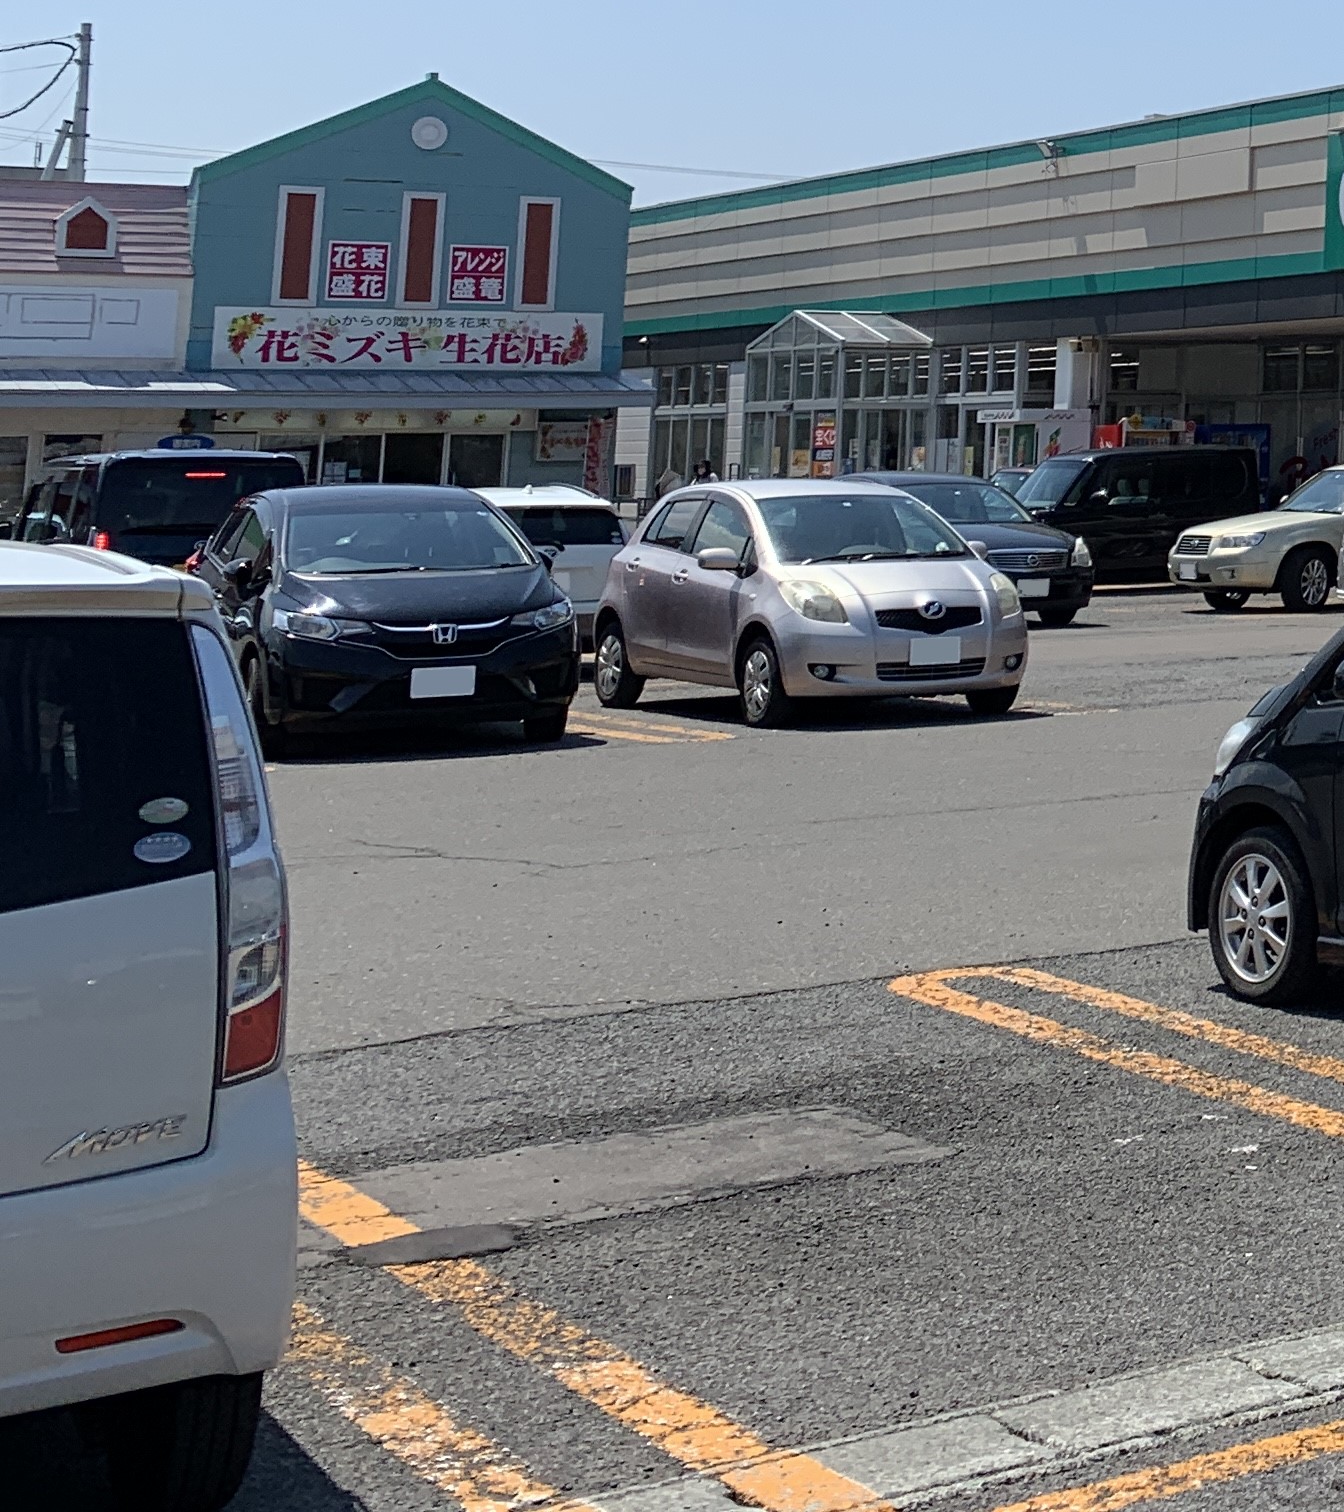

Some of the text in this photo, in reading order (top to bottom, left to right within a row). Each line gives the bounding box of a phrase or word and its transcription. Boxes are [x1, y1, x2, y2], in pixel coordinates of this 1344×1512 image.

[332, 246, 385, 269] 花束
[453, 251, 504, 272] アレンジ
